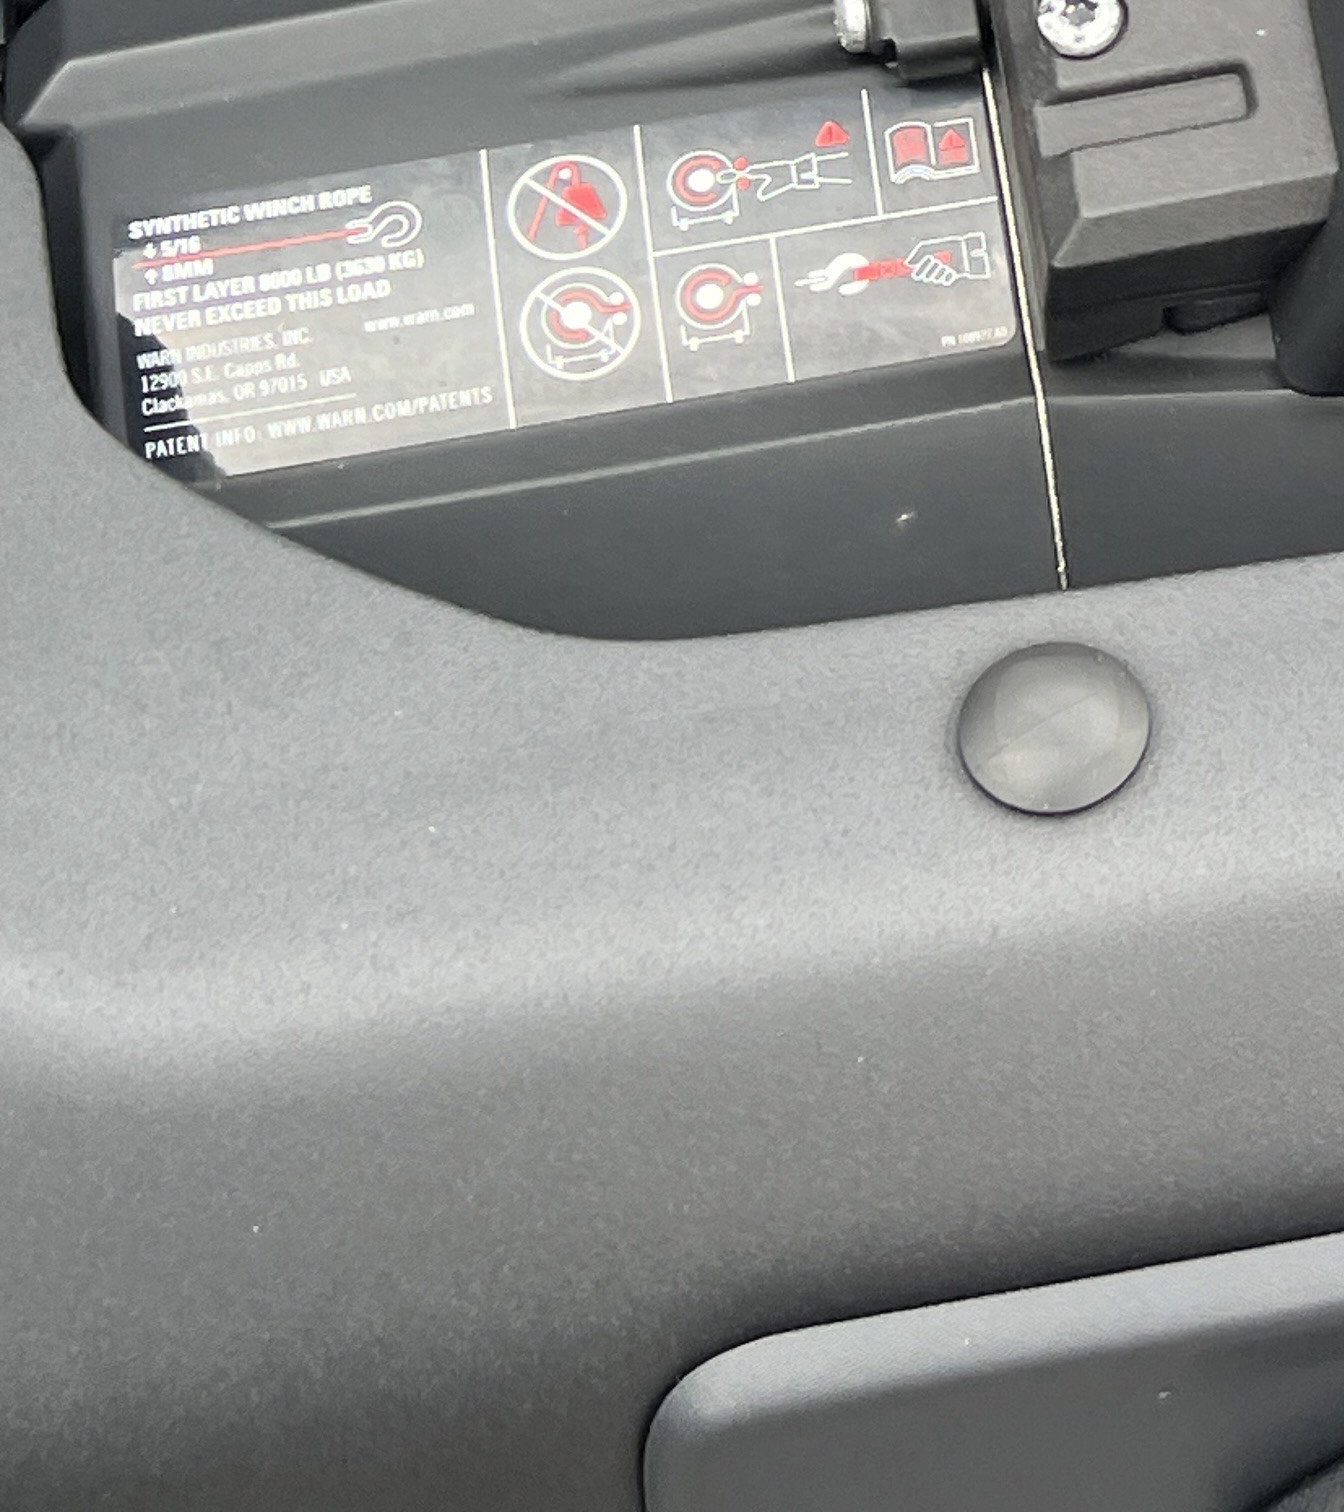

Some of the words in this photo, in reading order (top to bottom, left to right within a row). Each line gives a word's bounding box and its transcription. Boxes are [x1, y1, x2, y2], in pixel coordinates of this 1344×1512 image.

[127, 205, 241, 240] SYNTHETIC
[243, 193, 315, 222] WINCH
[318, 184, 373, 210] ROPE
[132, 285, 190, 313] FIRST
[192, 275, 256, 303] LAYER
[305, 262, 332, 284] LB
[387, 247, 425, 271] KG)
[134, 308, 201, 337] NEVER
[204, 296, 282, 326] EXCEED
[284, 287, 334, 313] THIS
[336, 278, 392, 305] LOAD
[364, 302, 476, 333] www.warn.com
[136, 349, 183, 370] WARN
[140, 370, 188, 394] 12900
[233, 382, 256, 401] OR
[258, 372, 308, 397] 97015
[319, 365, 352, 388] USA
[144, 432, 209, 460] PATENT
[266, 385, 495, 439] WWW.WARN.COM/PATENTS
